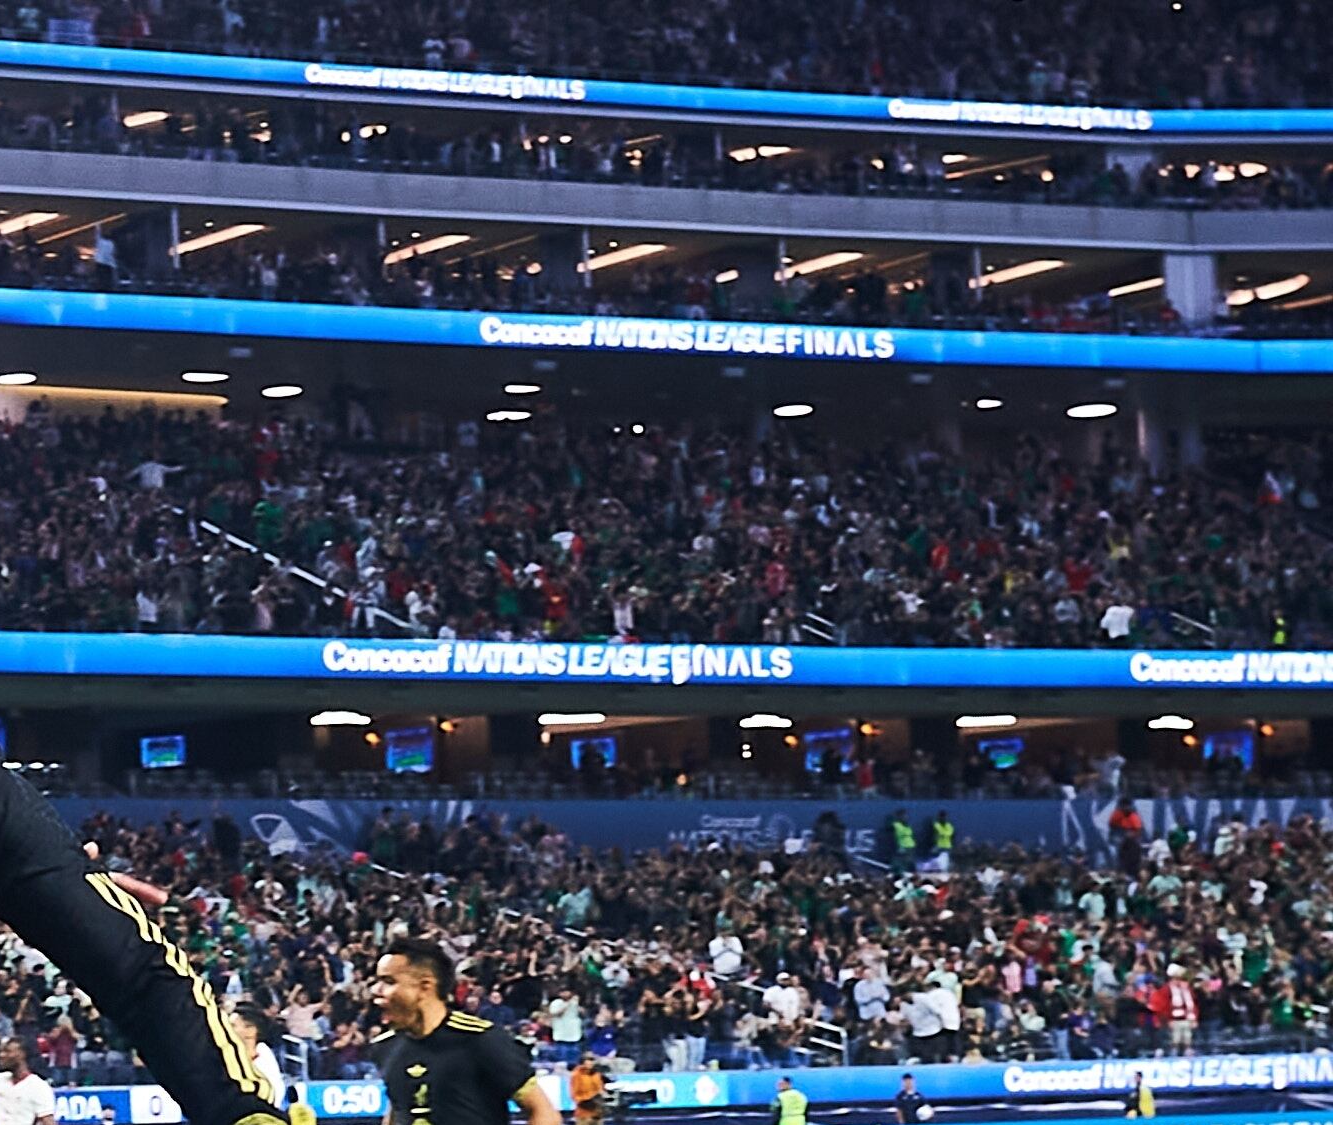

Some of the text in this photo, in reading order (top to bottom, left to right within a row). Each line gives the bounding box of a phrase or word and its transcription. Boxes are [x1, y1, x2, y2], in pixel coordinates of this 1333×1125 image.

[595, 320, 694, 351] NATIONS
[694, 325, 786, 354] LEAGUE
[786, 327, 895, 359] FINALS
[322, 642, 453, 673] Concacaf
[453, 642, 566, 676] NATIONS
[567, 644, 672, 677] LEAGUE
[323, 1085, 381, 1115] 0:50
